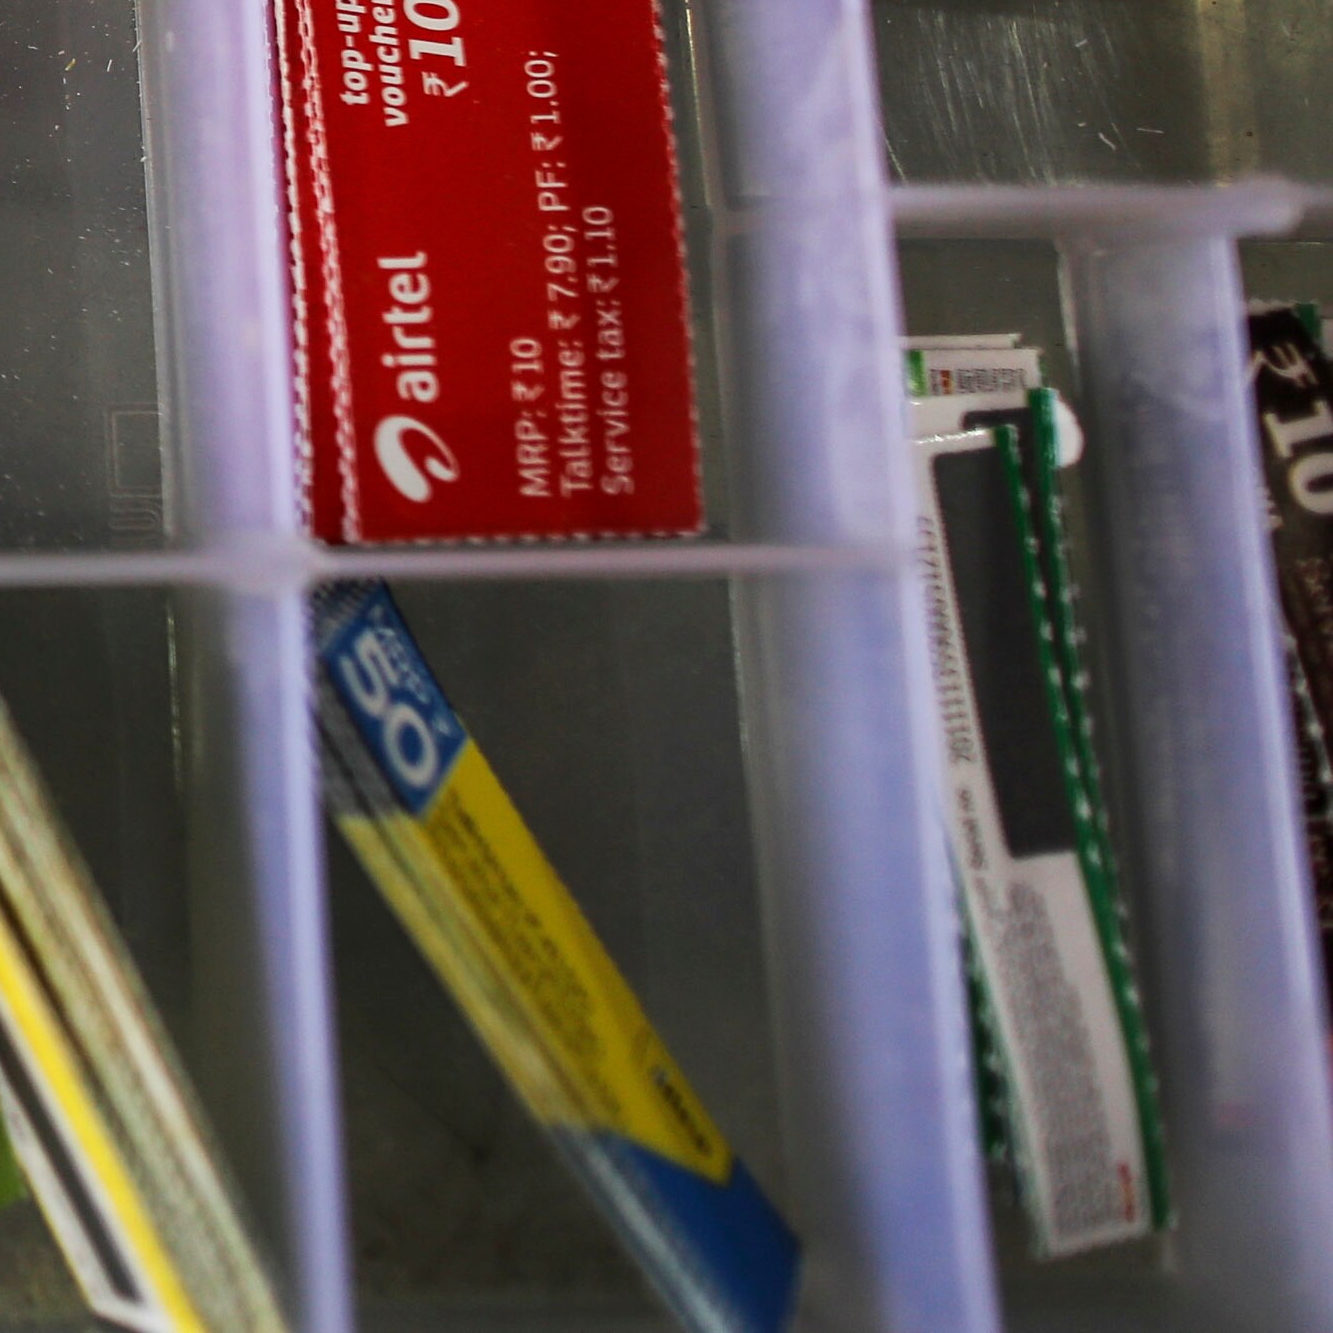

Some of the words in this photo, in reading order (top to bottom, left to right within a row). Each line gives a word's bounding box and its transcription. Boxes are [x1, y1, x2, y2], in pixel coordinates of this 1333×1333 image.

[537, 162, 571, 212] PF:
[377, 251, 438, 404] airtel
[595, 302, 627, 362] tax:
[517, 411, 551, 497] MRP:
[557, 339, 593, 497] Talktime:
[601, 370, 632, 495] Service
